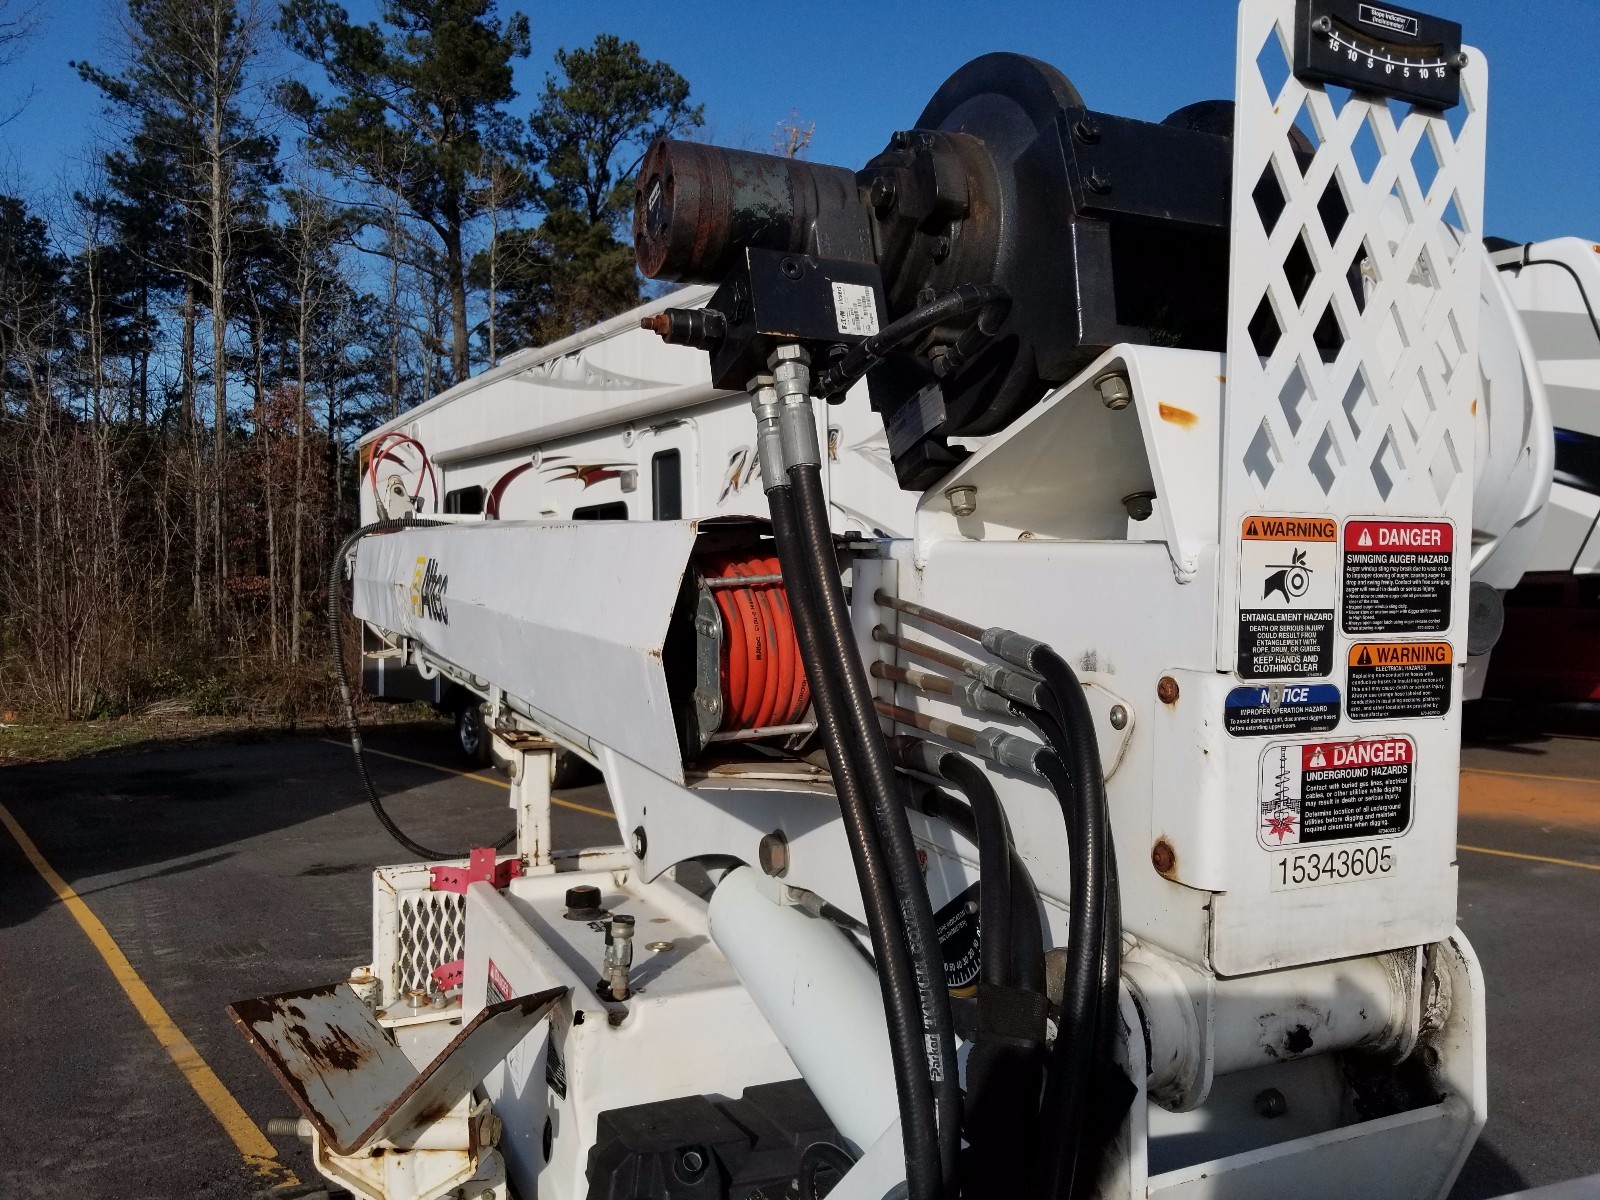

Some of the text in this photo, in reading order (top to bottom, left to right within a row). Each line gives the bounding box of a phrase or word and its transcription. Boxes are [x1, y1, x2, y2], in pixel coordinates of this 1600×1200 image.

[1329, 38, 1340, 52] 15
[1348, 50, 1358, 62] 10
[1367, 58, 1374, 68] 5
[1404, 68, 1410, 78] 5
[1418, 68, 1428, 78] 10
[1435, 67, 1445, 78] 15
[1261, 520, 1334, 538] WARNING
[1379, 528, 1441, 546] DANGER
[1346, 554, 1448, 564] SWINGING AUGER HAZARD
[1241, 612, 1333, 622] ENTANGLEMENT HAZARD
[1254, 656, 1274, 664] KEEP
[1276, 656, 1300, 664] HANDS
[1376, 646, 1446, 662] WARNING
[1254, 664, 1318, 672] CLOTHING CLEAR
[1260, 688, 1310, 704] NTICE
[1272, 706, 1304, 714] OPERATION
[1334, 742, 1406, 766] DANGER
[1306, 765, 1408, 782] UNDERGROUND HAZARDS
[1370, 803, 1402, 812] underground
[1304, 825, 1326, 833] required
[1278, 846, 1392, 884] 15343605
